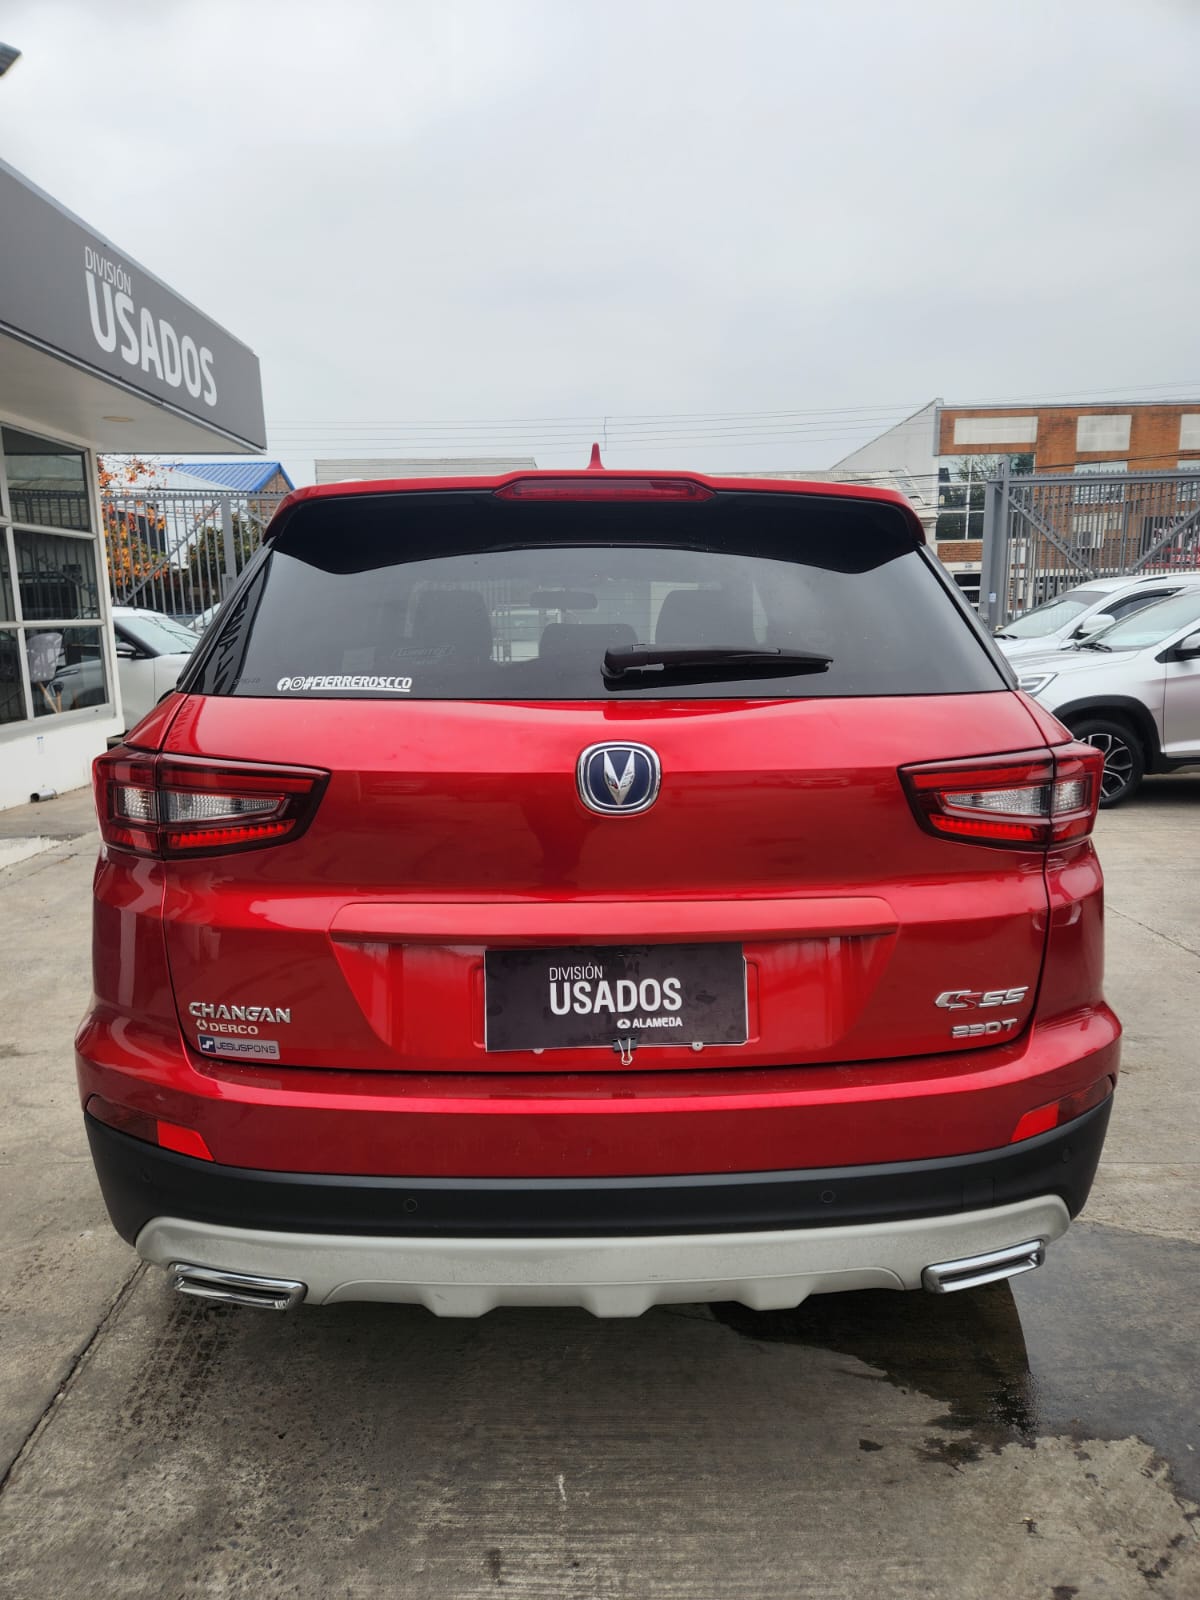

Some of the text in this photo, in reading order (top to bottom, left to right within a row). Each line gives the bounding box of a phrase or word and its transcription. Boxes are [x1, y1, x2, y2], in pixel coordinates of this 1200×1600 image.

[85, 246, 131, 296] DIVISIÓN
[85, 270, 217, 407] USADOS
[549, 962, 603, 981] DIVISIÓN
[549, 977, 682, 1015] USADOS
[188, 1001, 291, 1024] CHANGAN
[632, 1016, 683, 1029] ALAMEDA
[209, 1022, 259, 1035] DERCO
[216, 1041, 277, 1054] JESUSPONS
